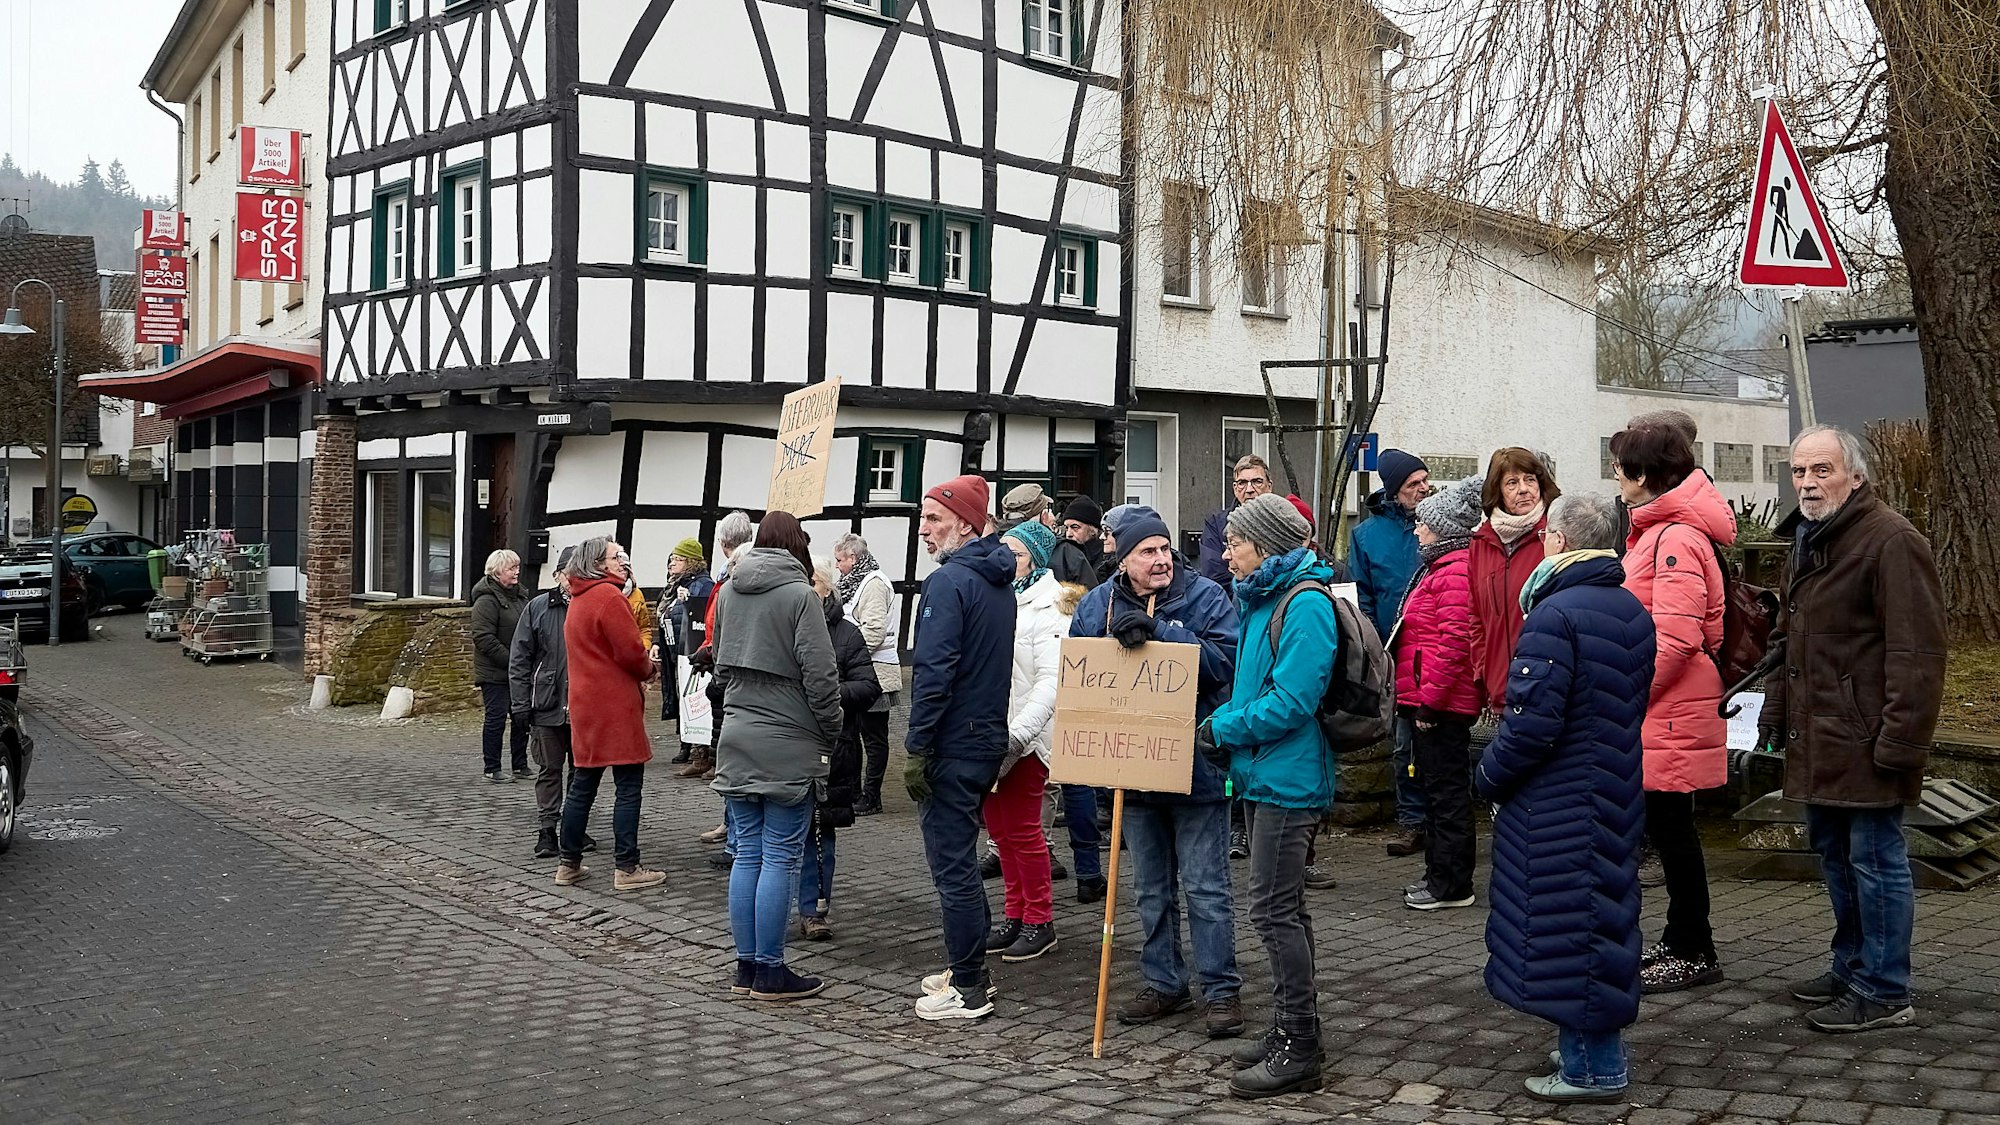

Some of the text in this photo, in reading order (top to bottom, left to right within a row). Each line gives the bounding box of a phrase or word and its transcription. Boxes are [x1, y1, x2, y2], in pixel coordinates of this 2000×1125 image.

[264, 138, 282, 147] Über
[264, 149, 282, 157] 5000
[258, 158, 287, 168] Artikel!
[260, 198, 278, 278] SPAR
[280, 198, 298, 281] LAND
[144, 270, 184, 279] SPAR
[143, 278, 184, 286] LAND
[1061, 654, 1189, 693] Merz AfD
[1110, 696, 1130, 708] MIT
[1061, 730, 1182, 762] NEE-NEE-NEE
